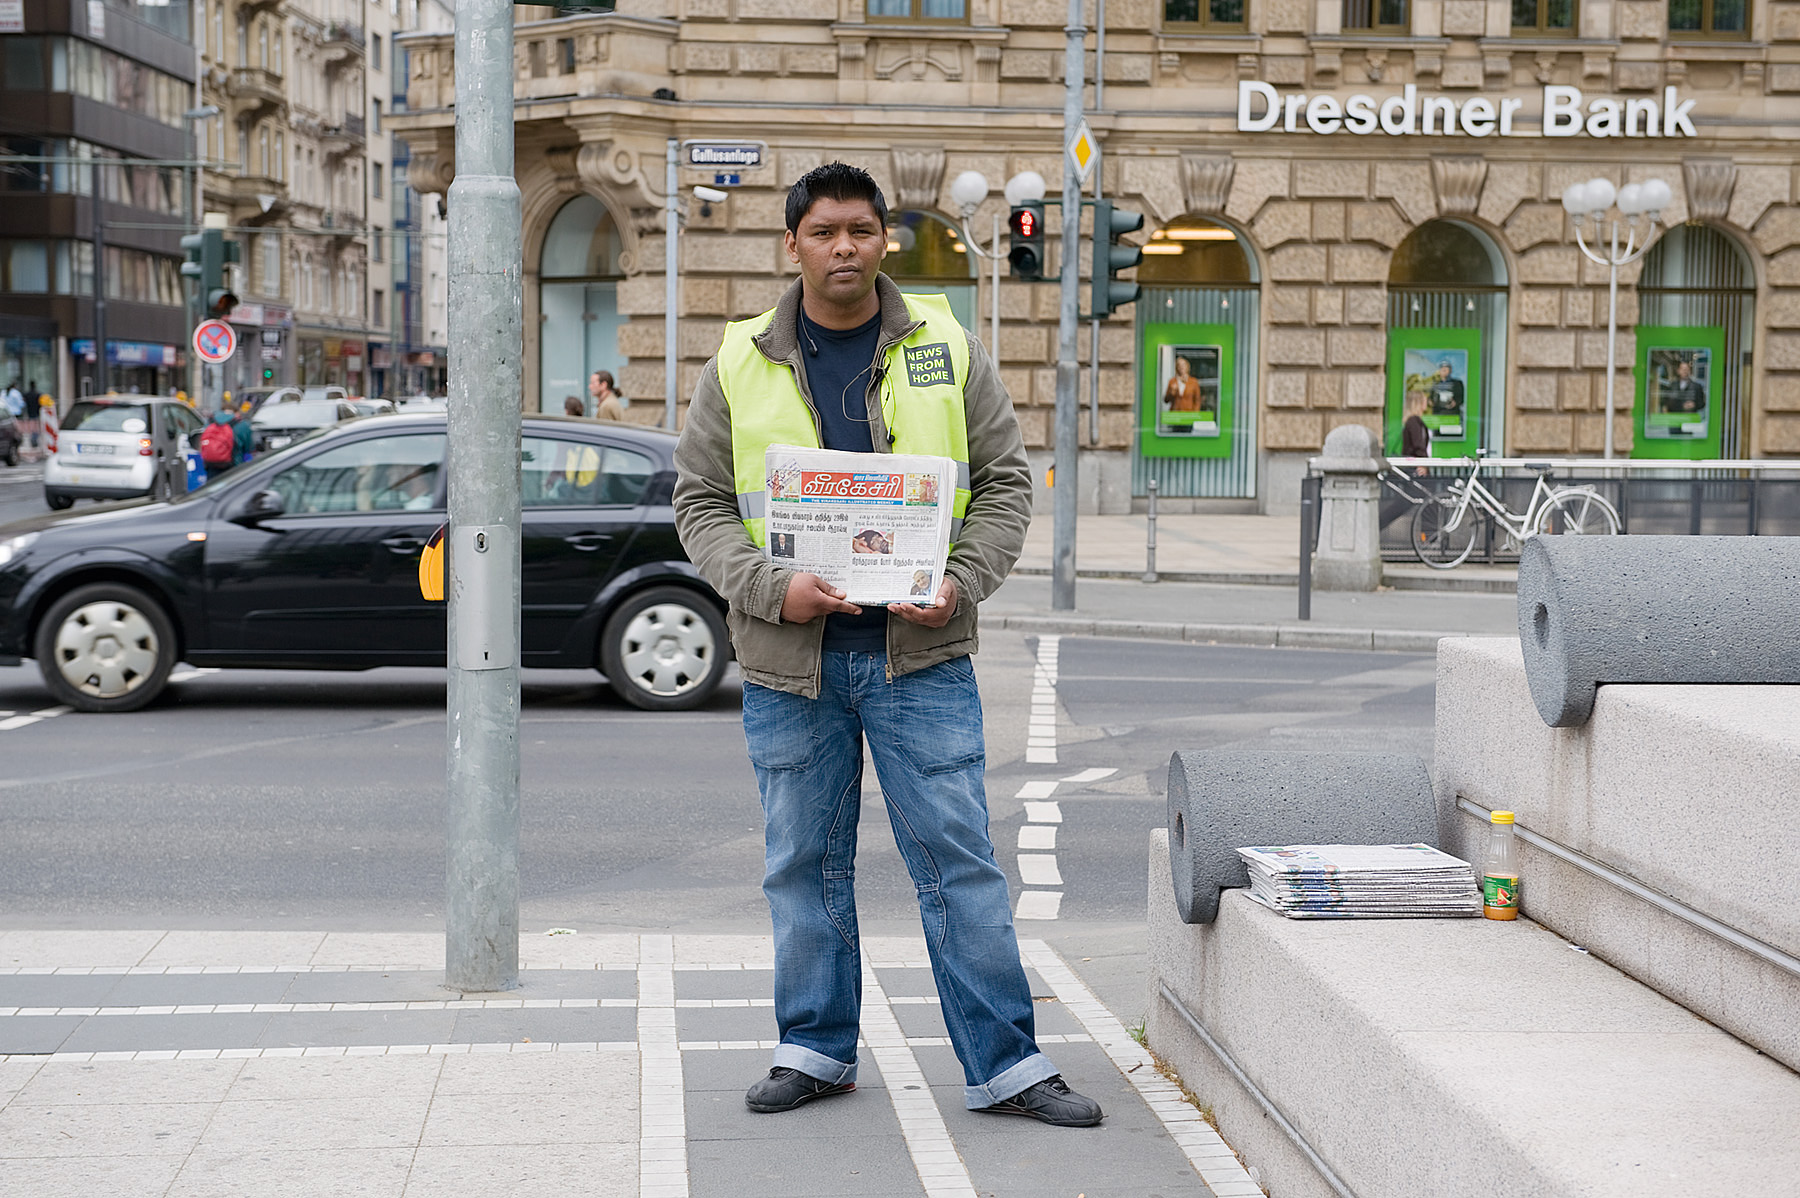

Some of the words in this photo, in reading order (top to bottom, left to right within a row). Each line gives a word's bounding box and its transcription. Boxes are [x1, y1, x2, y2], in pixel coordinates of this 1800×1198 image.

[1237, 80, 1523, 137] Dresdner
[1542, 84, 1698, 138] Bank
[691, 148, 759, 165] Gallusanlage
[906, 346, 943, 361] NEWS
[909, 359, 945, 372] FROM
[912, 370, 949, 384] HOME
[803, 473, 901, 497] வீரகேசரி
